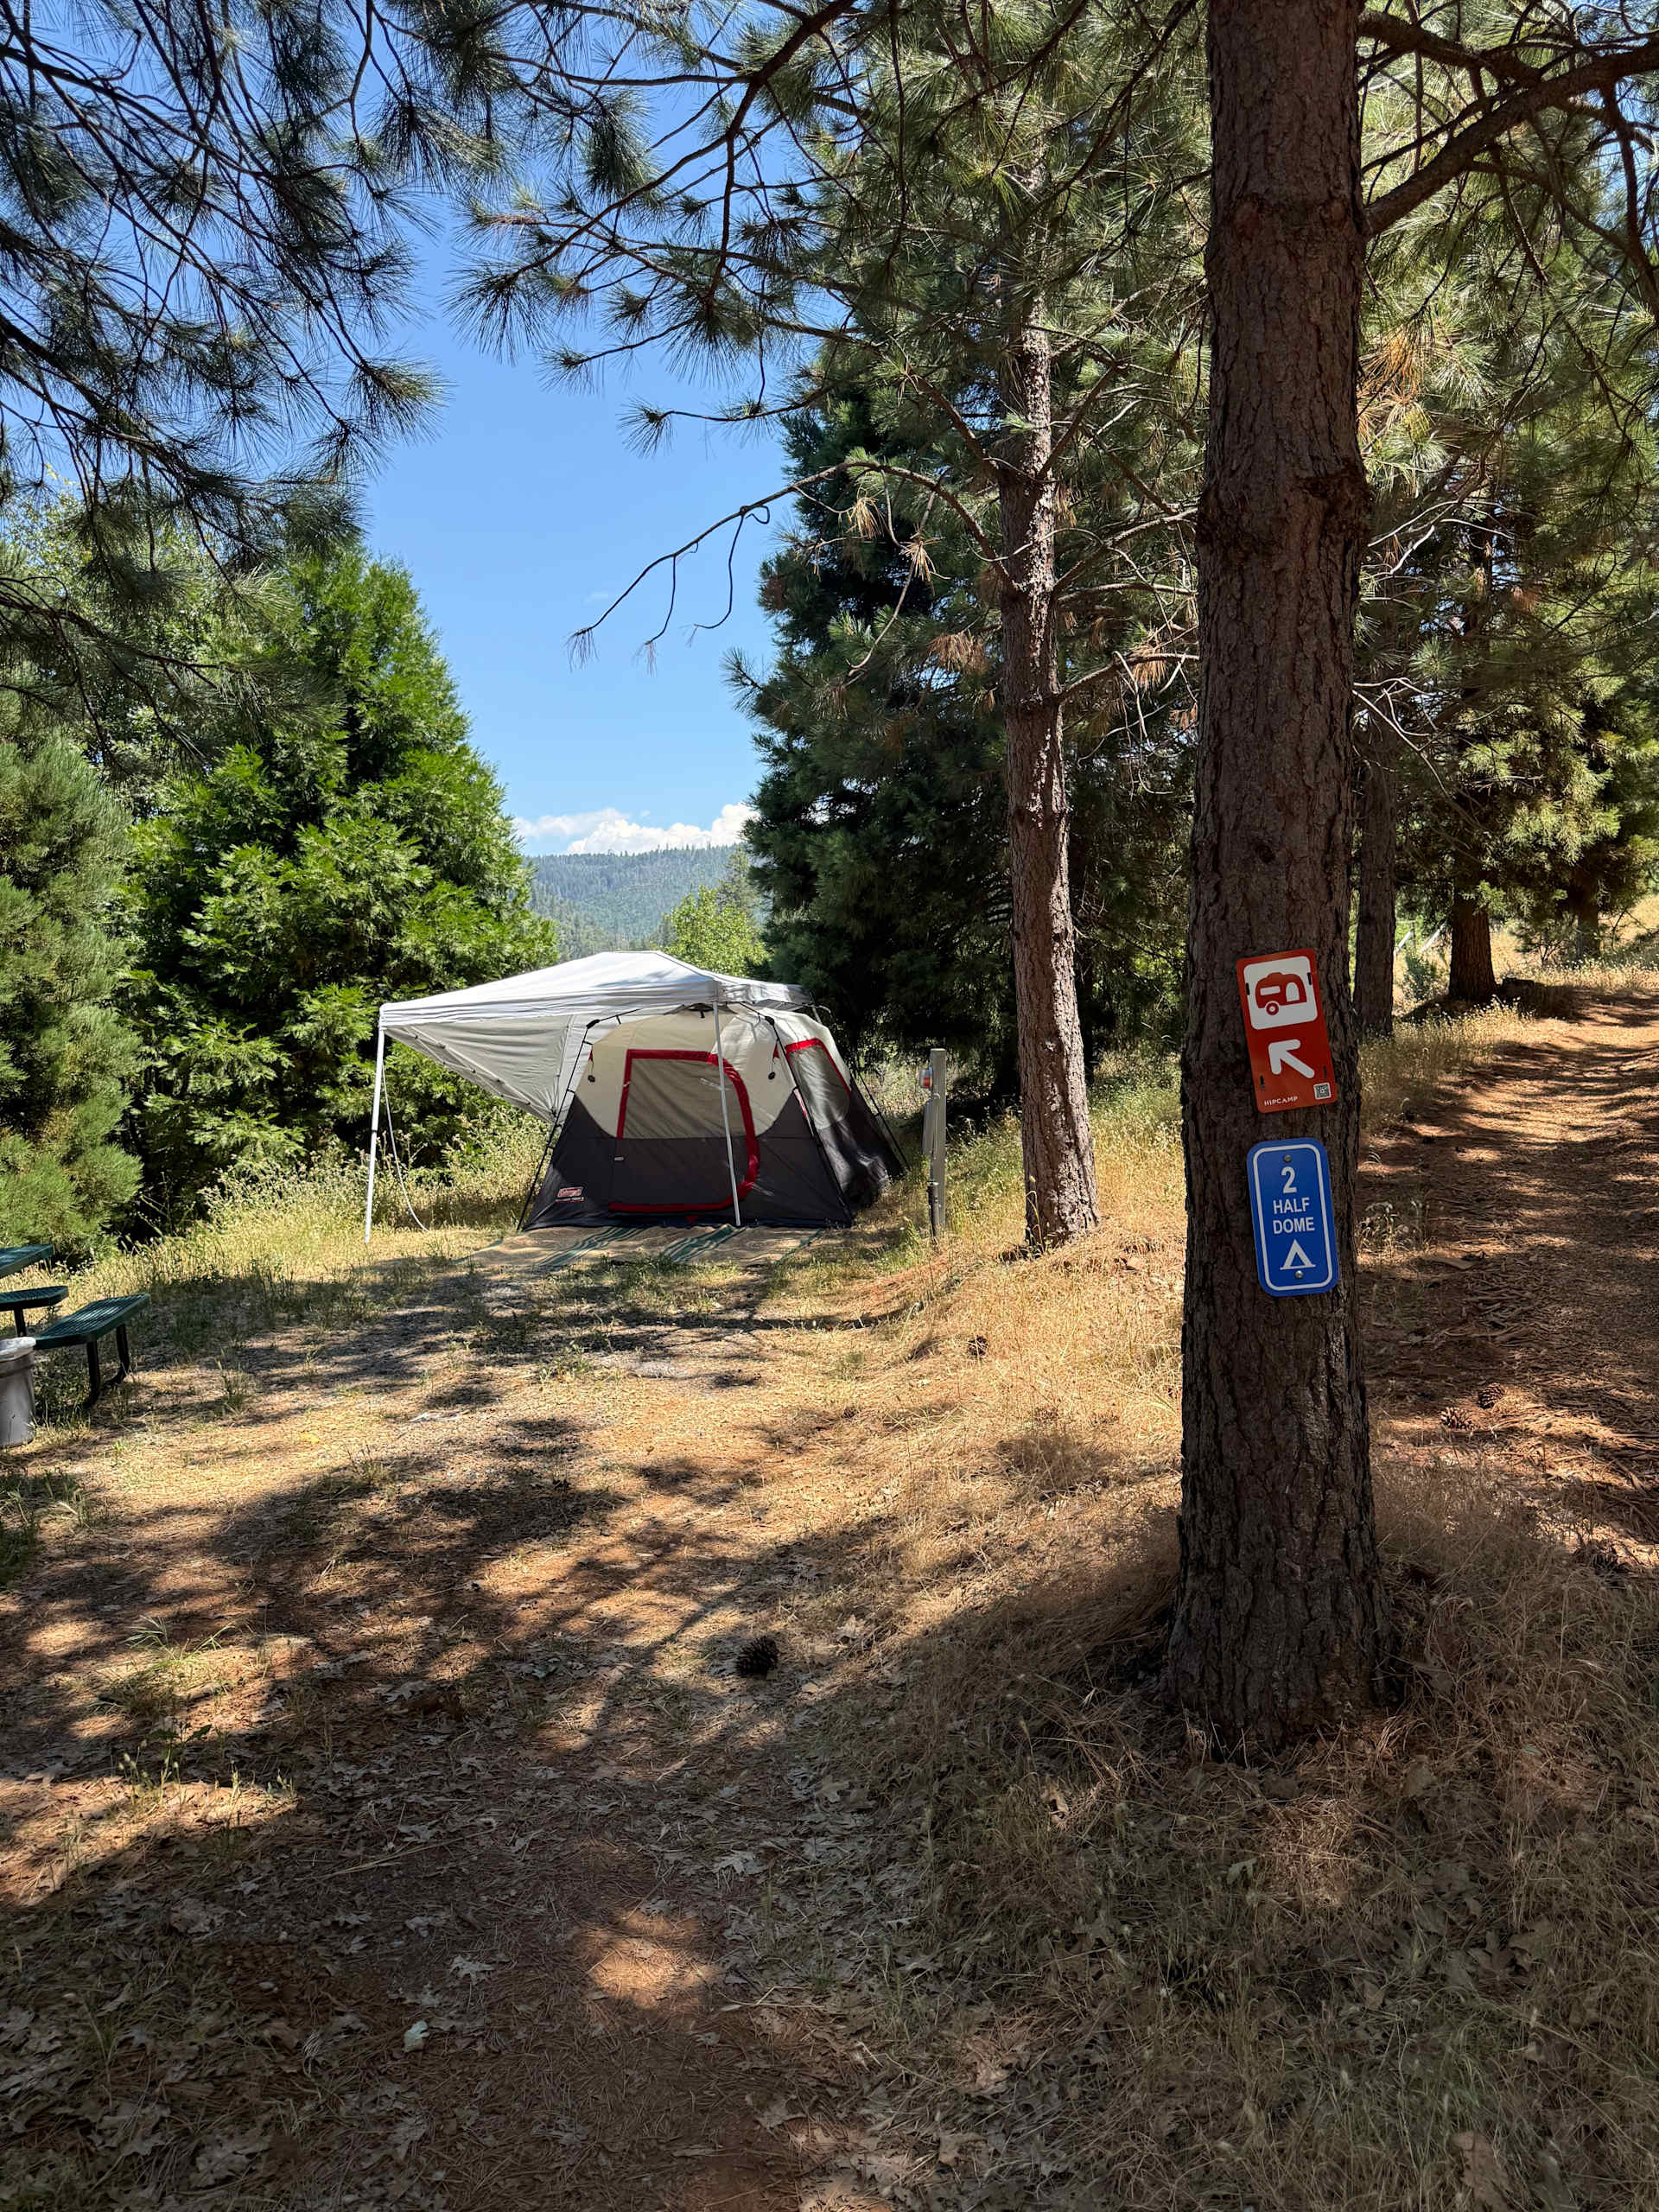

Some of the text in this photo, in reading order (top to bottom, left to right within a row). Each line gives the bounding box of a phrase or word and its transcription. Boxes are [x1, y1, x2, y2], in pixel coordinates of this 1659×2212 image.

[1264, 1096, 1299, 1107] HIPCAMP
[1281, 1166, 1297, 1194] 2
[1273, 1197, 1310, 1214] HALF
[1273, 1217, 1315, 1235] DOME
